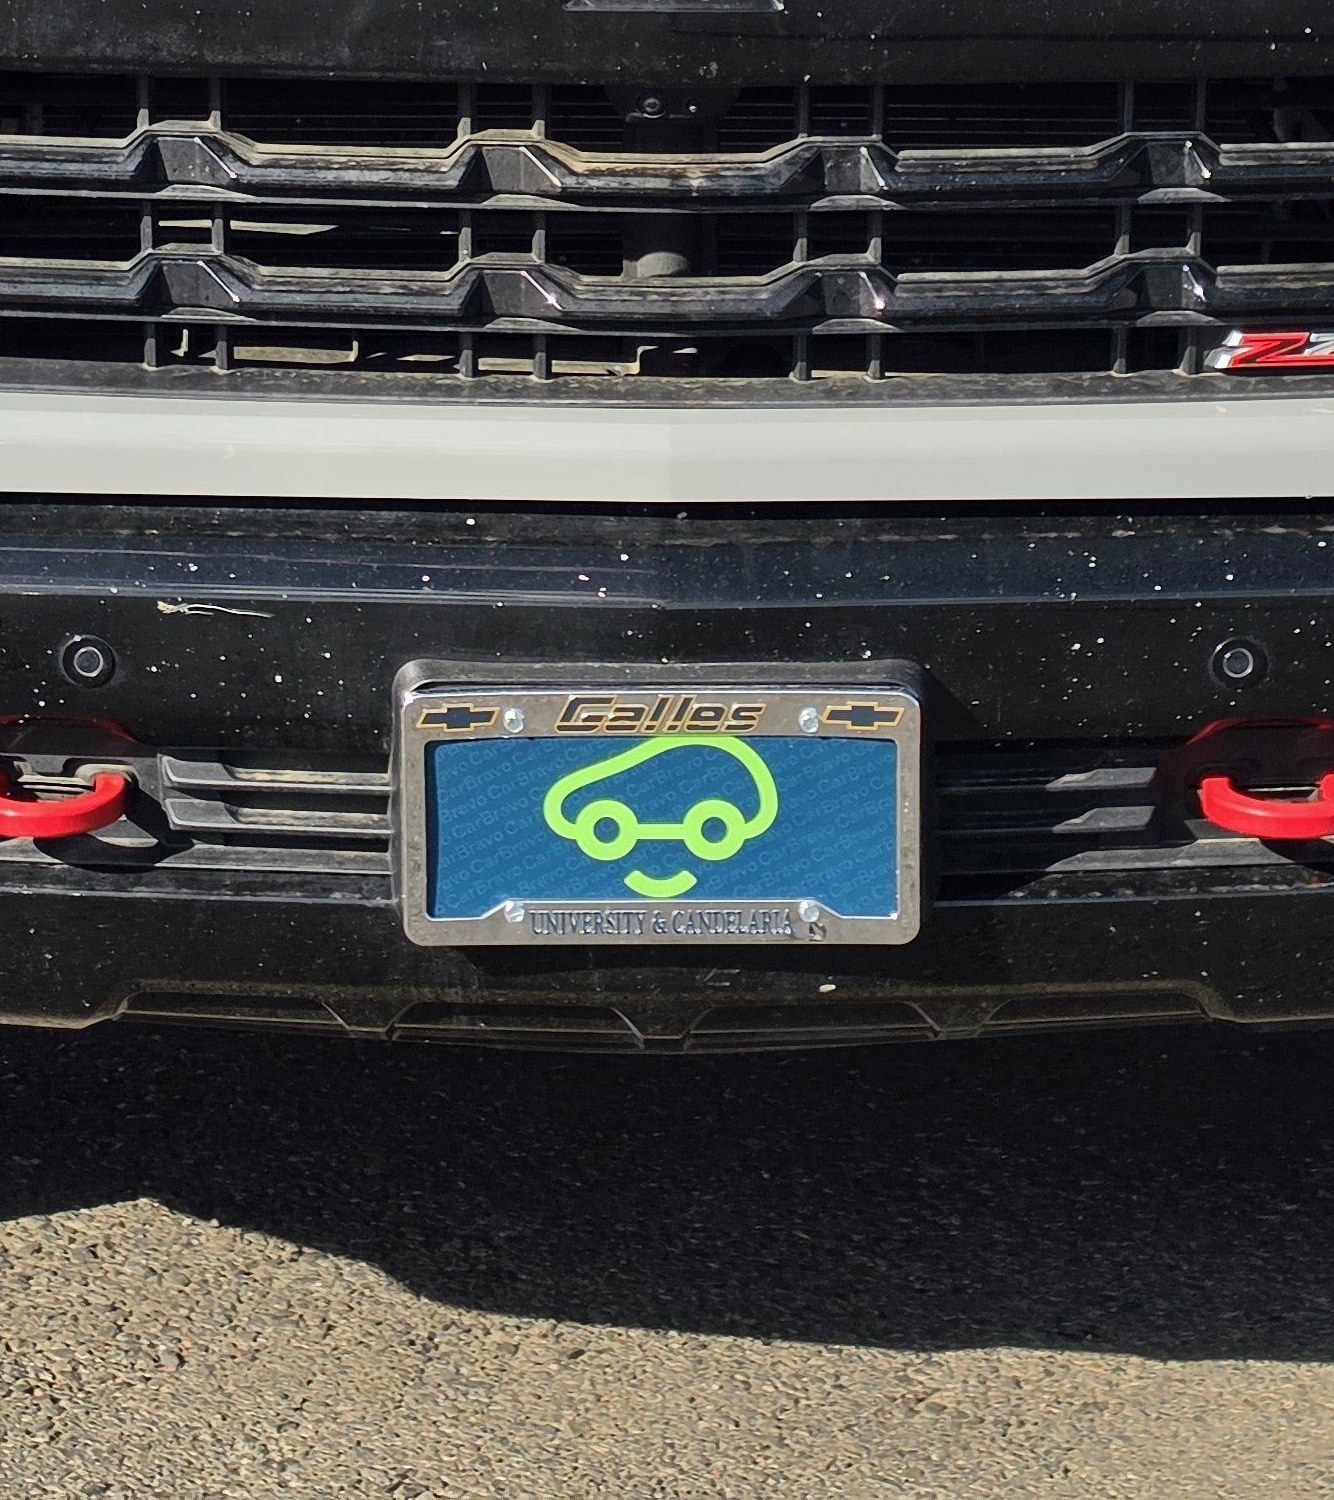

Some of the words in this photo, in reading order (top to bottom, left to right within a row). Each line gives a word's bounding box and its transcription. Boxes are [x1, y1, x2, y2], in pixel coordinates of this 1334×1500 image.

[528, 908, 648, 936] UNIVERSITY
[651, 908, 669, 936] &
[672, 908, 793, 936] CANDELARIA
